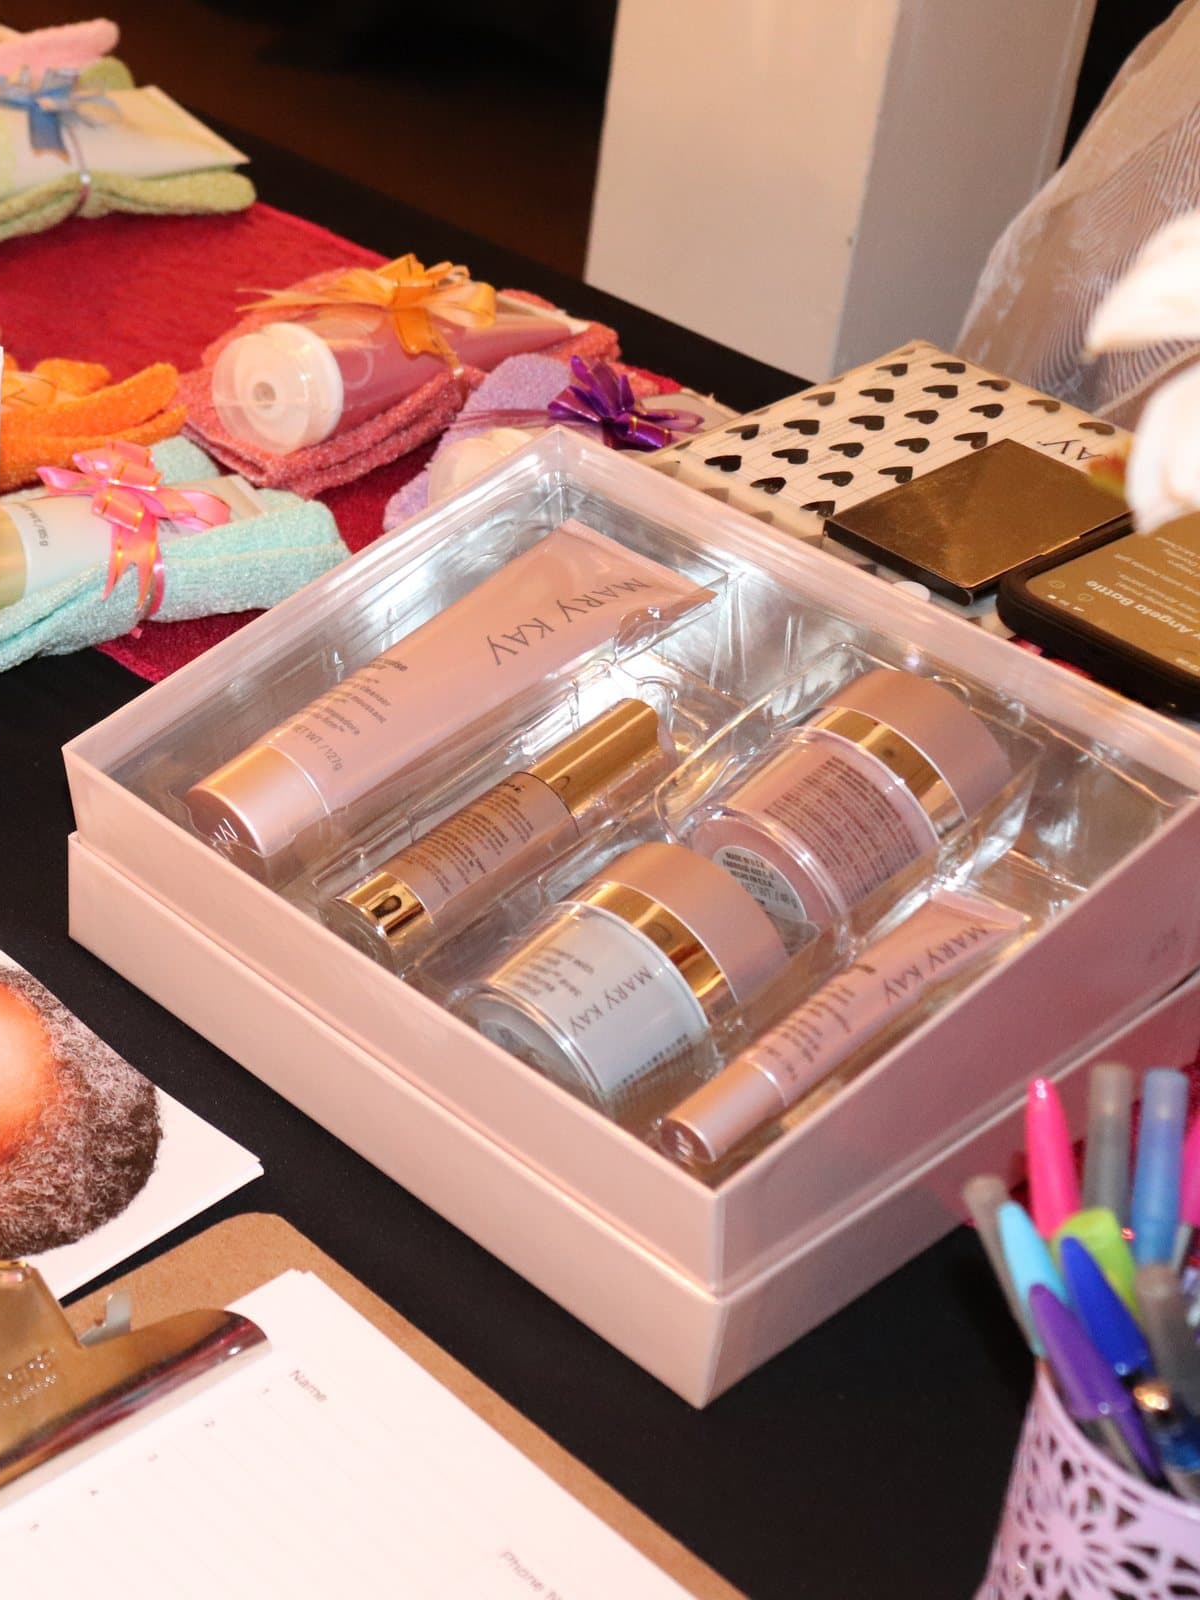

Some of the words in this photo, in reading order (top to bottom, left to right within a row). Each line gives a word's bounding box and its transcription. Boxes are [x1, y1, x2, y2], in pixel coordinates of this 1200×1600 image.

[557, 578, 652, 622] MARY
[1085, 579, 1134, 606] Battle
[487, 617, 555, 666] KAY
[926, 924, 990, 972] MARY
[604, 965, 654, 1010] MARY
[882, 964, 924, 1005] KAY
[570, 1003, 603, 1037] KAY
[289, 1368, 329, 1404] Name
[501, 1549, 549, 1596] Phone
